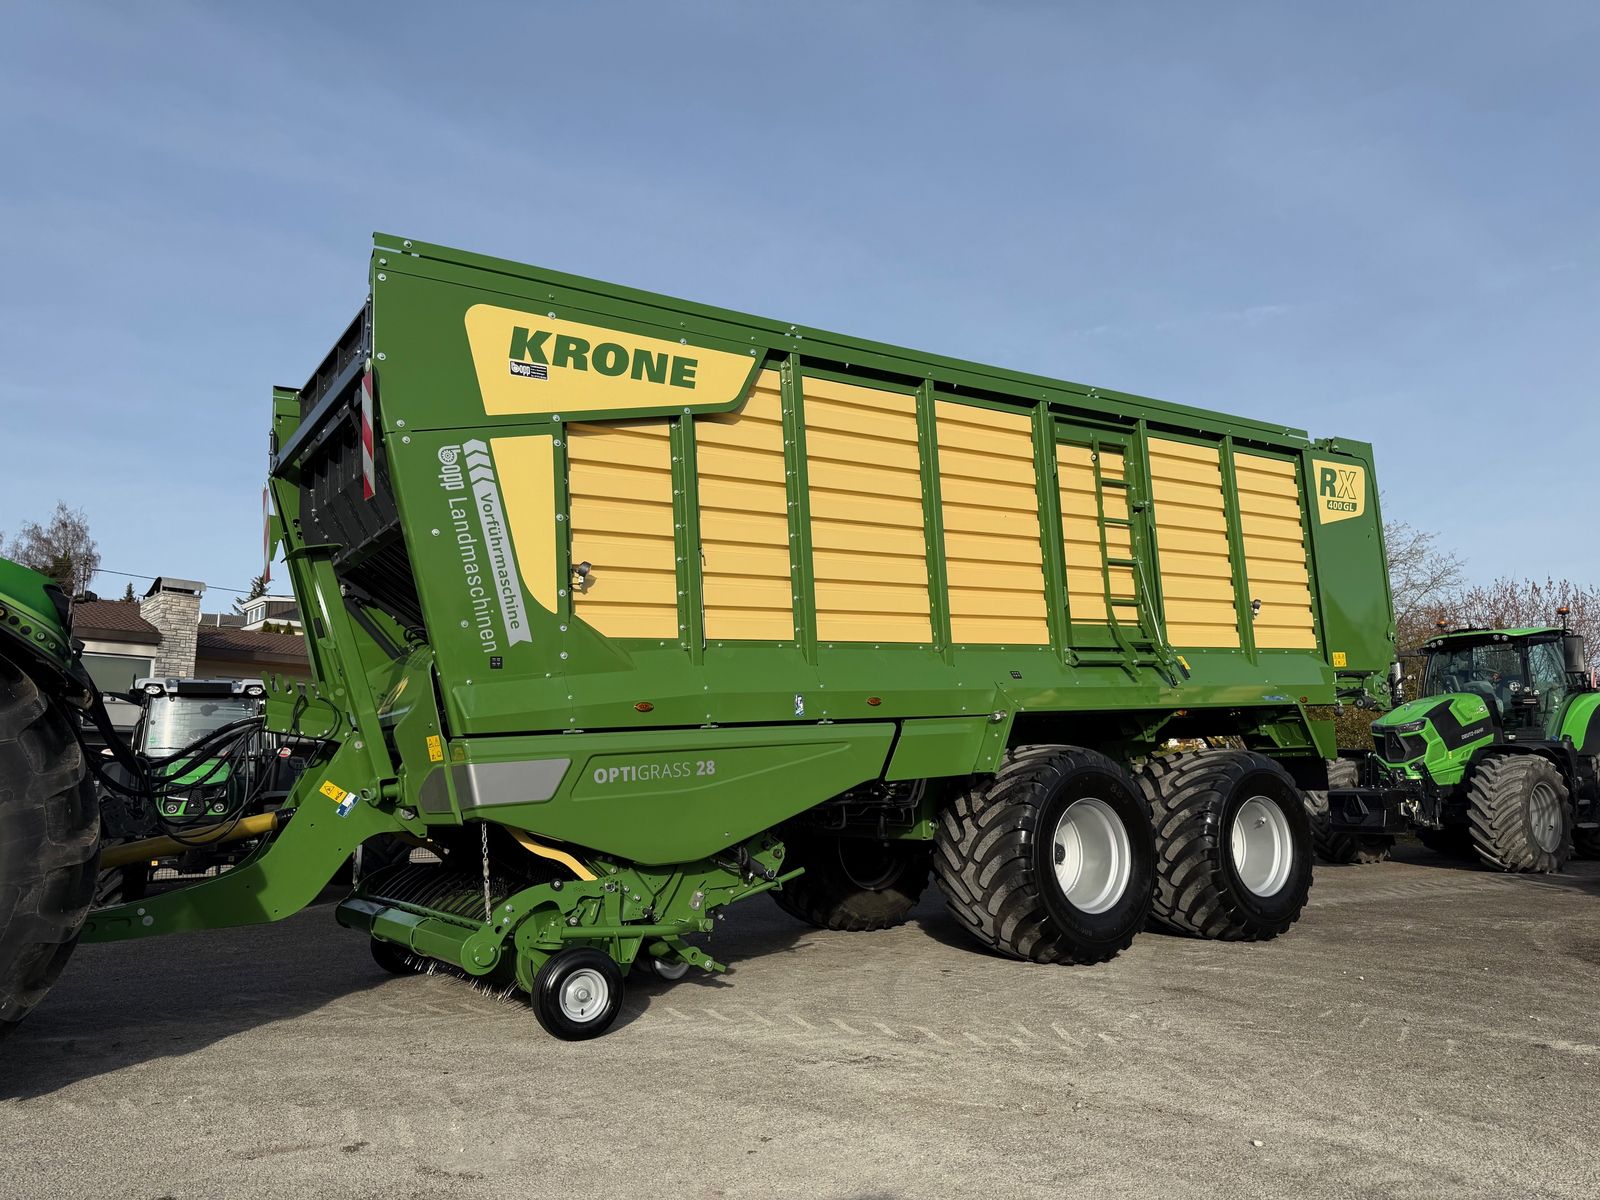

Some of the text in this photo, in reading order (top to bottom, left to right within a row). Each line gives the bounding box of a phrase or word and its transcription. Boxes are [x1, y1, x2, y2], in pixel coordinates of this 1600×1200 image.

[508, 325, 698, 390] KRONE
[1320, 467, 1356, 499] RX
[1328, 501, 1354, 511] 400 GL
[438, 444, 498, 654] bopp Landmaschinen
[480, 492, 520, 630] Vorführmaschine
[593, 760, 716, 784] OPTIGRASS 28
